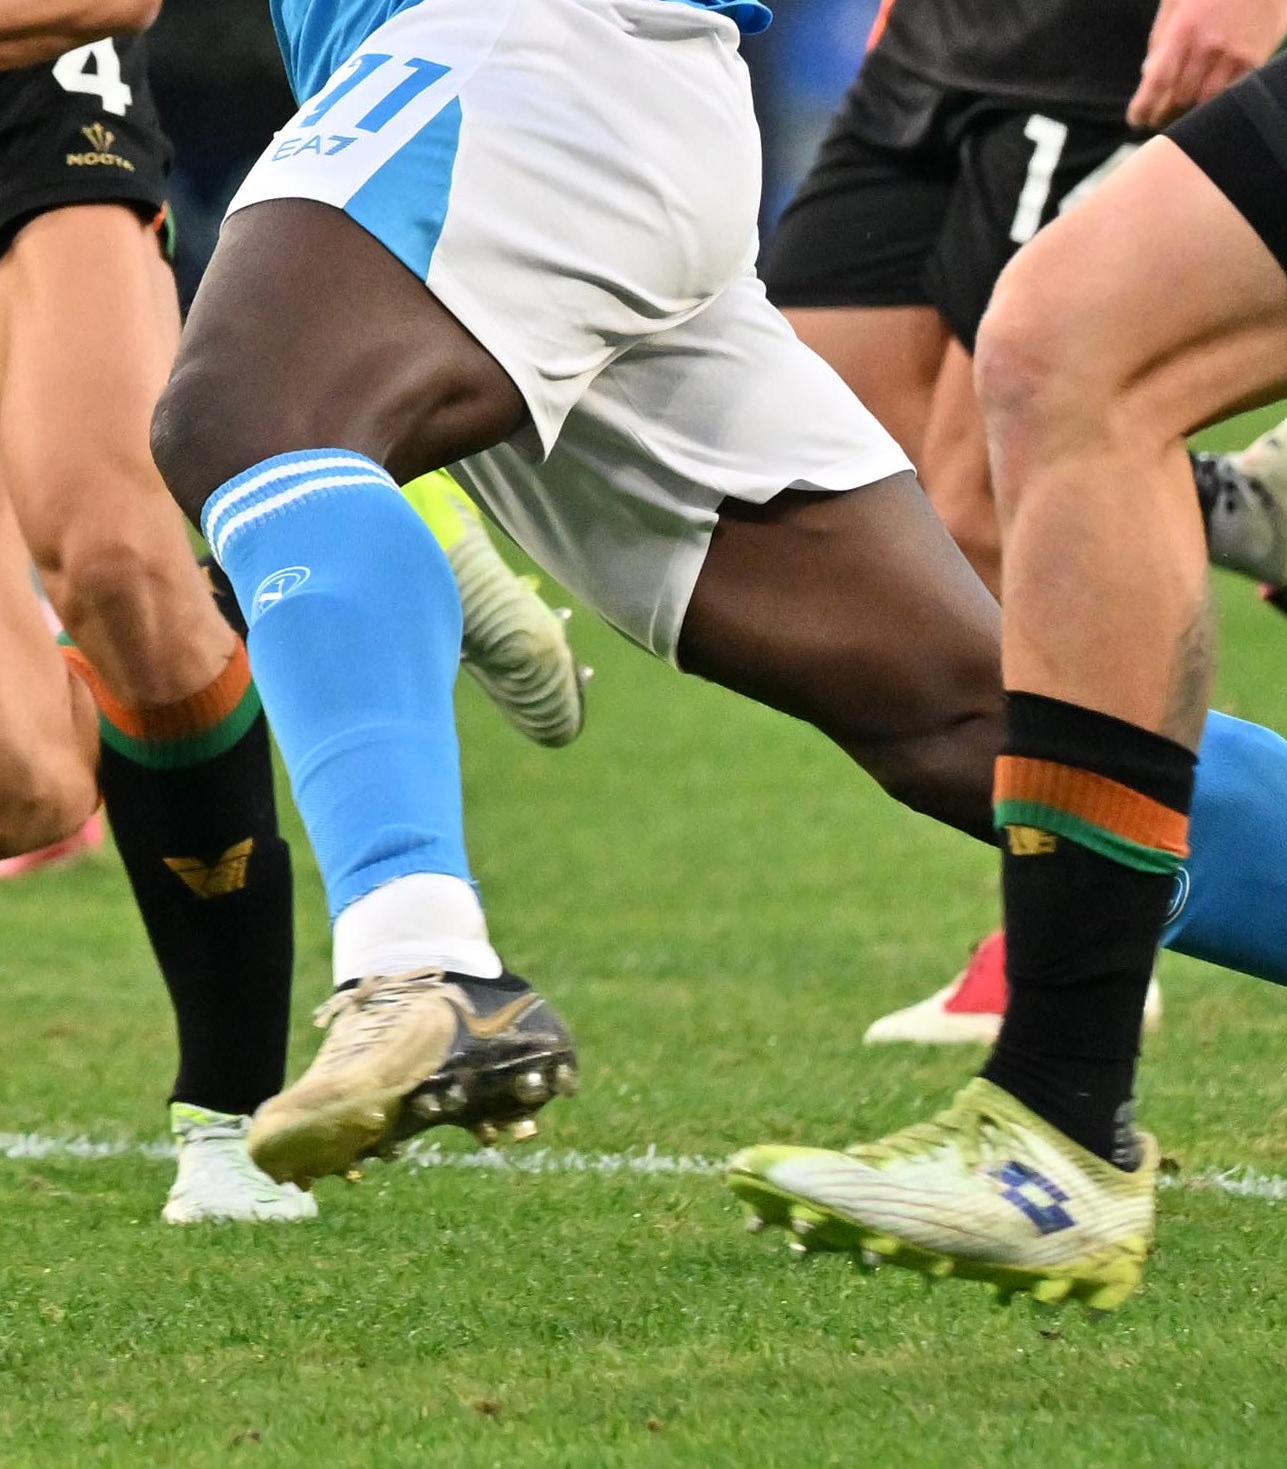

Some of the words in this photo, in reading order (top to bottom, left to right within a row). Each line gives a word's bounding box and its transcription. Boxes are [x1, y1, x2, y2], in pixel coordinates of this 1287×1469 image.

[52, 36, 133, 117] 4
[300, 53, 453, 134] 11
[271, 136, 358, 162] EA7
